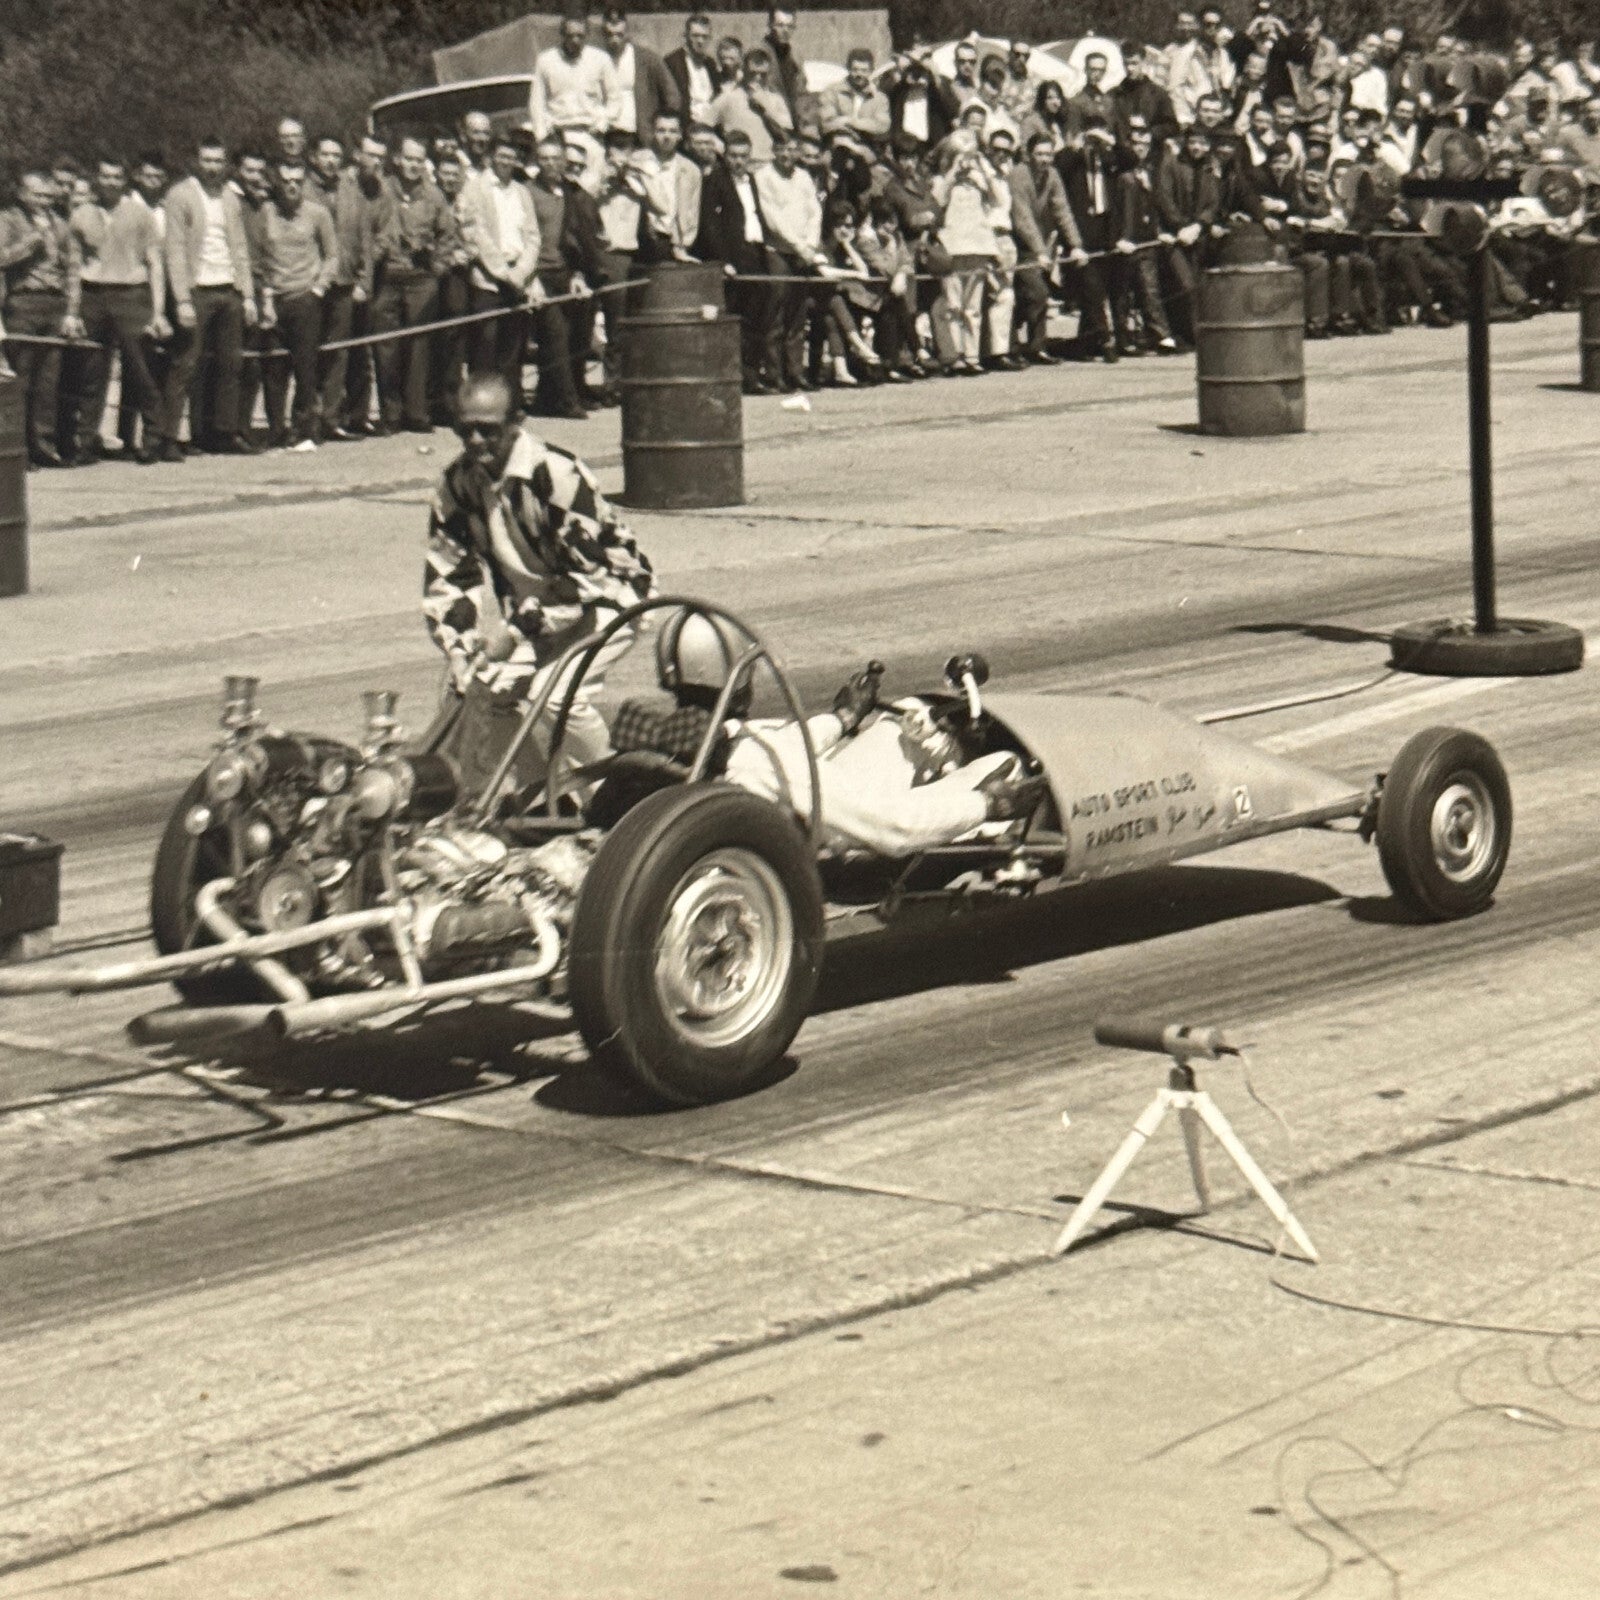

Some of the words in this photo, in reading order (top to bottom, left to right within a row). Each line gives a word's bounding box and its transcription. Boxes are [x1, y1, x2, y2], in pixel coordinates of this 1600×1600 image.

[1072, 793, 1110, 819] AUTO
[1113, 780, 1158, 808] SPORT
[1161, 772, 1196, 795] CLUB
[1235, 789, 1250, 814] 2
[1086, 816, 1159, 848] RAMSTEIN
